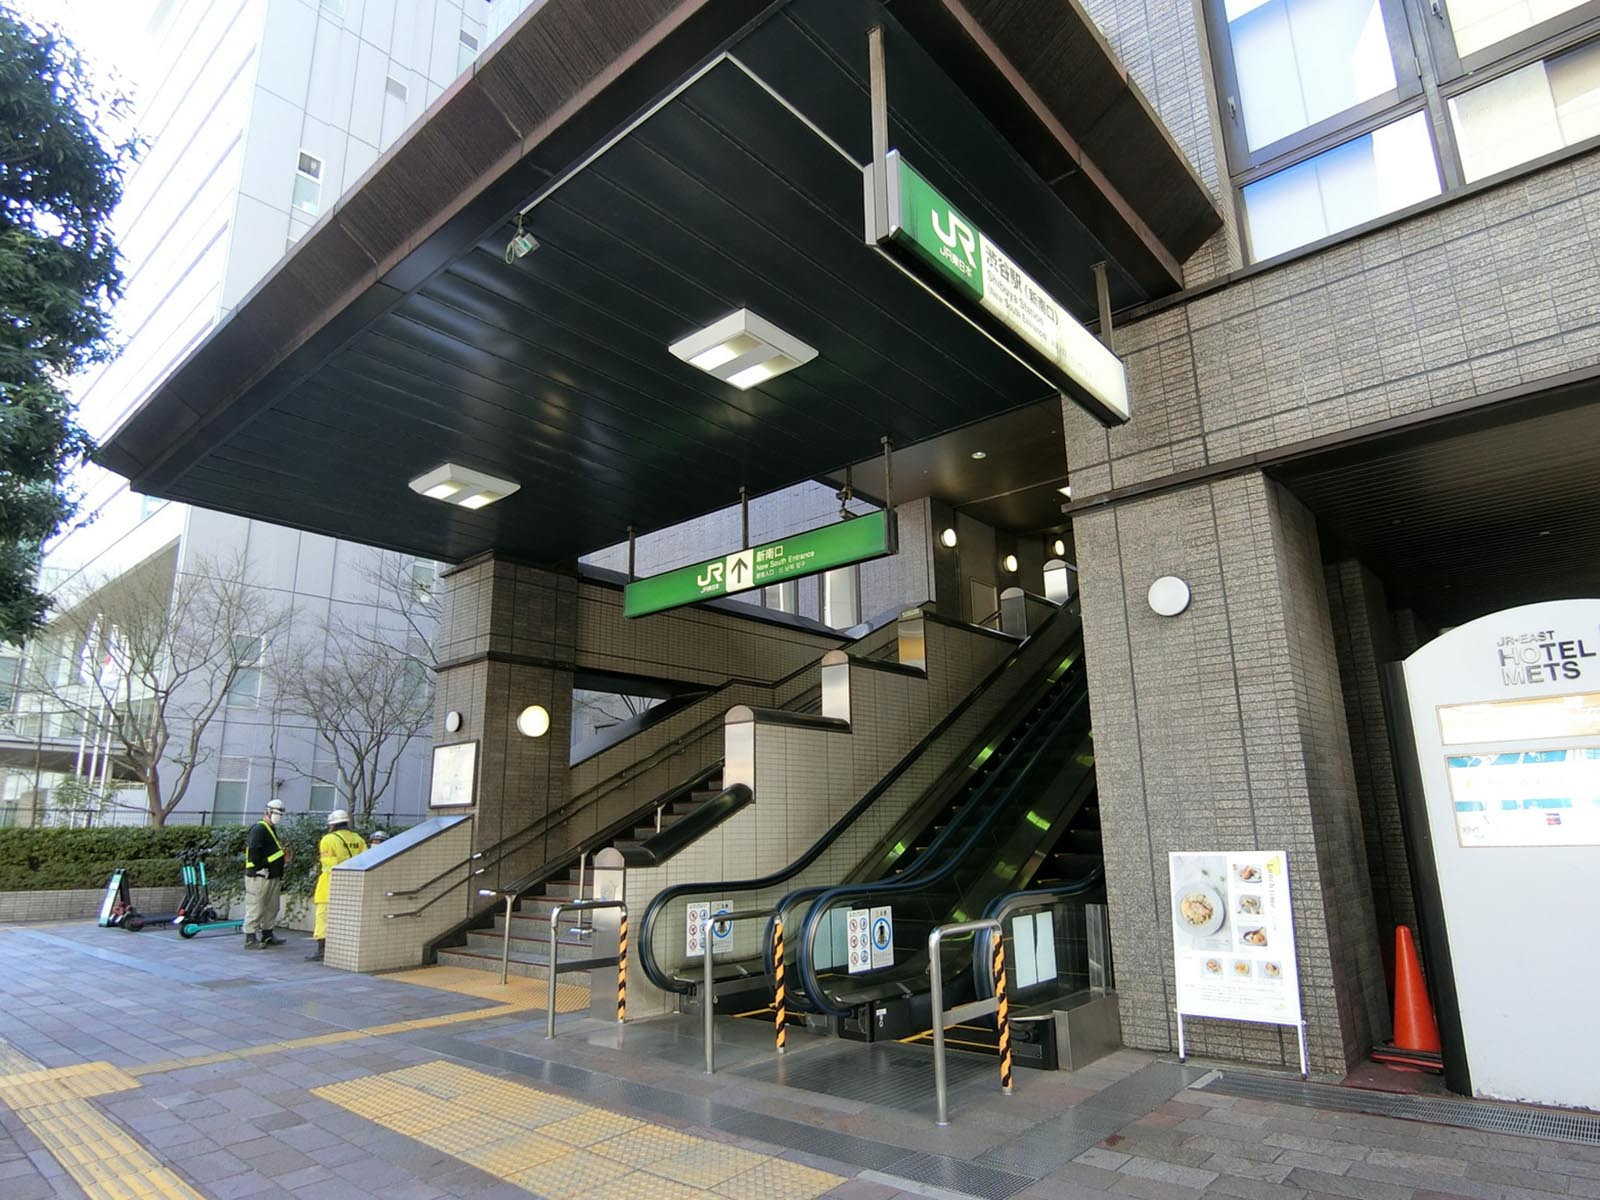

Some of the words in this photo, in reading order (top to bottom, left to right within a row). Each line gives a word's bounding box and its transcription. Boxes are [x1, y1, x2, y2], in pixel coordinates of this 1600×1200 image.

[931, 209, 976, 269] JR
[756, 545, 783, 562] 新南口
[756, 563, 769, 571] New
[770, 558, 787, 568] South
[788, 550, 815, 563] Entrance
[697, 562, 724, 586] JR
[1497, 630, 1555, 647] JR-EAST
[1497, 639, 1597, 667] HOTEL
[1501, 660, 1581, 687] METS
